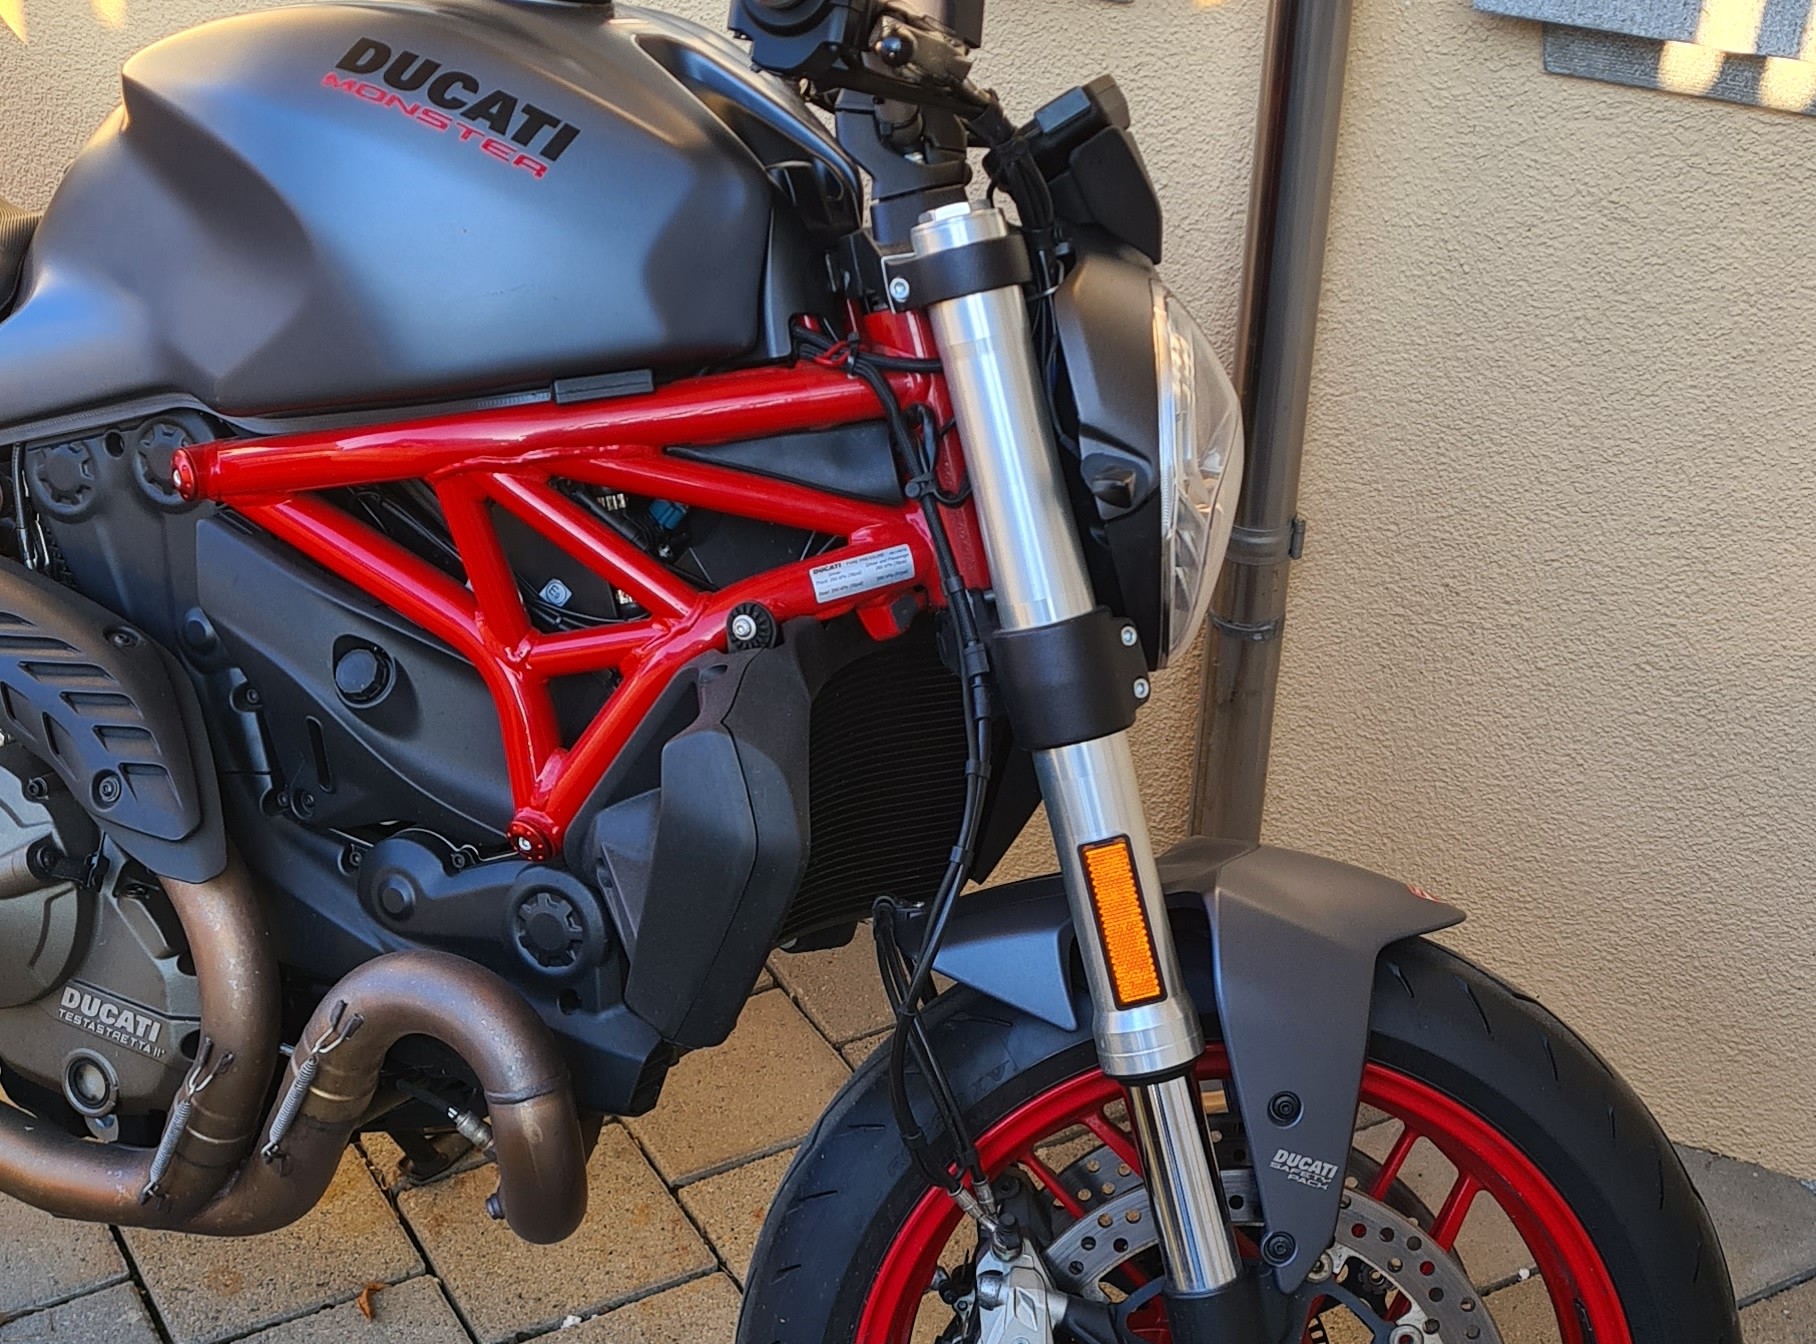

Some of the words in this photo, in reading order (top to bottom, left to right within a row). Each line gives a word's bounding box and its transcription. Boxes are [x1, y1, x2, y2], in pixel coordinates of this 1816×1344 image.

[335, 36, 580, 162] DUCATI
[321, 71, 548, 179] MONSTER
[58, 1008, 151, 1054] TESTASTRETTA
[61, 986, 161, 1043] DUCATI
[1269, 1161, 1332, 1184] SAFETY
[1272, 1148, 1339, 1179] DUCATI
[1286, 1173, 1329, 1191] PACK
